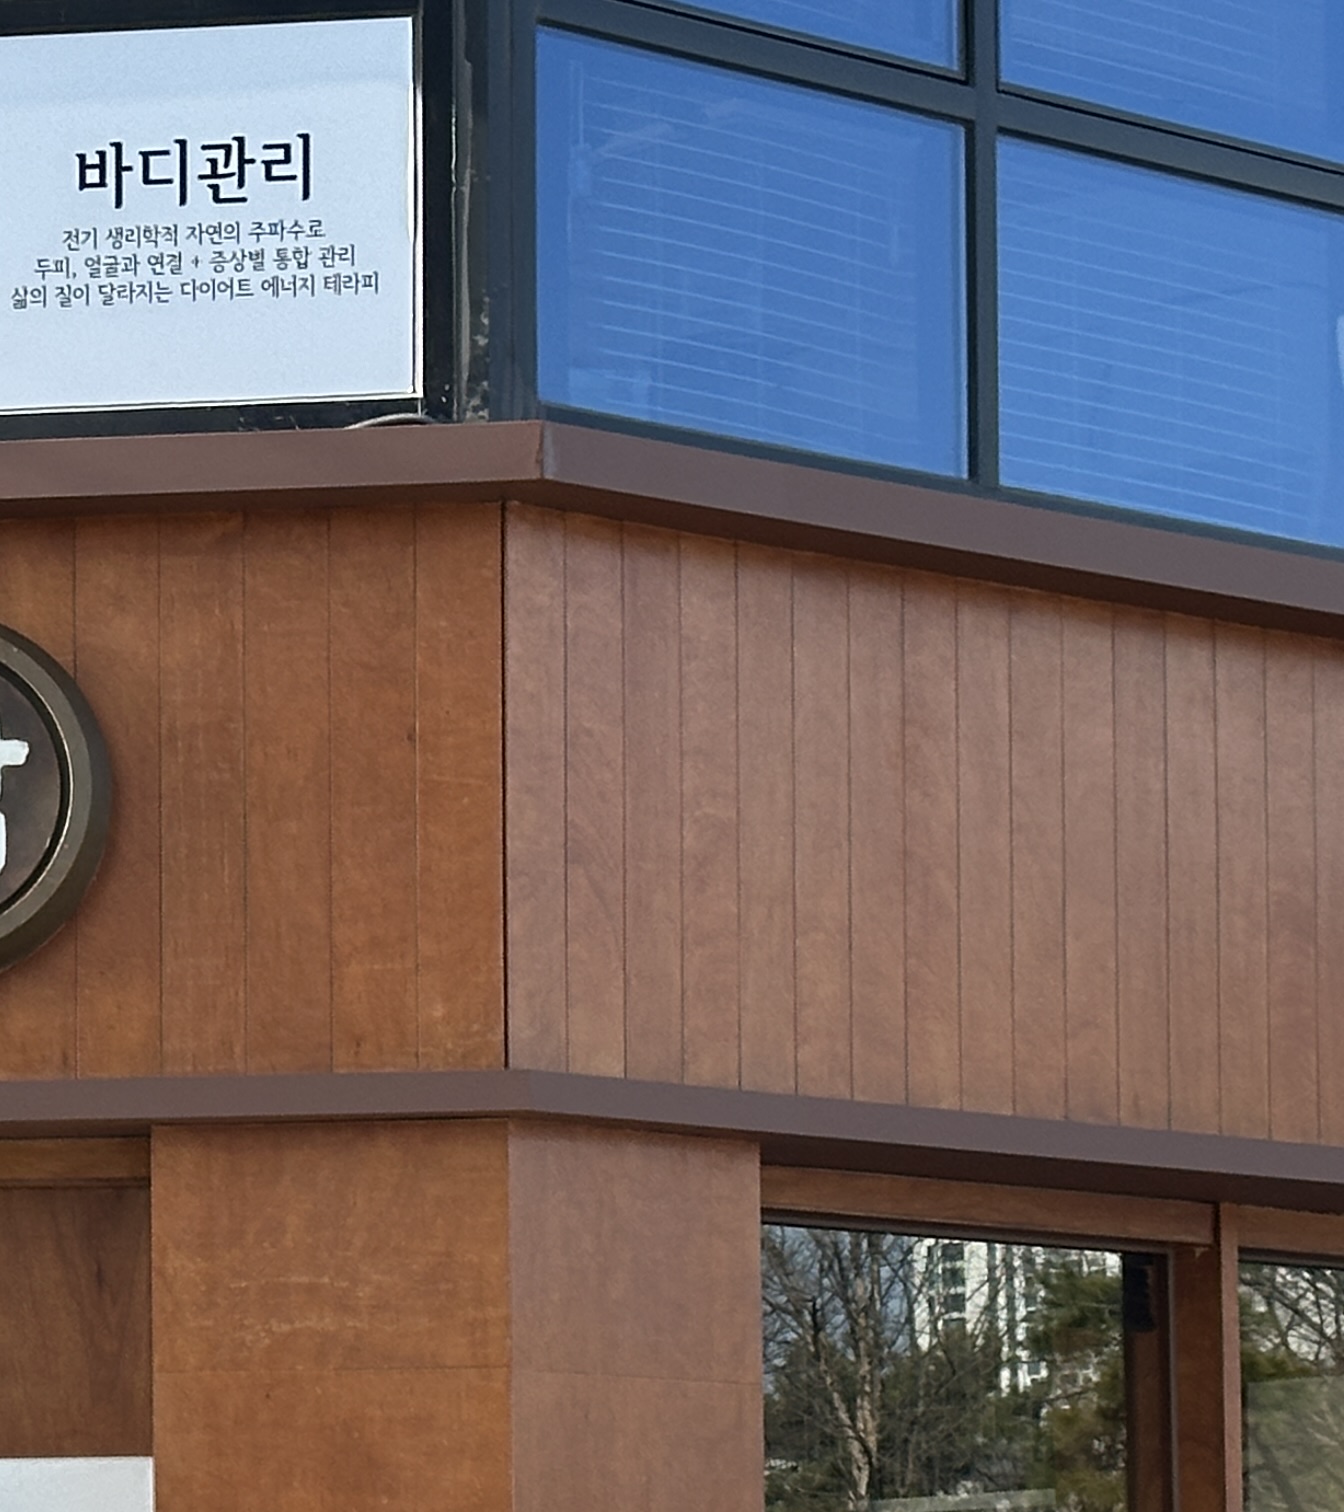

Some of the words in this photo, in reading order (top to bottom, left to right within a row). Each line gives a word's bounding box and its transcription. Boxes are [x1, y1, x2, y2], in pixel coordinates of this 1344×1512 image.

[75, 132, 314, 210] 바디관리
[62, 227, 98, 252] 전기
[184, 220, 241, 247] 자연의
[248, 218, 325, 244] 주파수로
[34, 256, 77, 281] 두피,
[83, 253, 142, 280] 얼굴과
[273, 245, 312, 271] 통합
[318, 243, 358, 269] 관리
[11, 285, 48, 310] 삶의
[54, 282, 91, 308] 질이
[97, 279, 173, 307] 달라지는
[179, 276, 255, 303] 다이어트
[261, 274, 316, 300] 에너지
[323, 270, 381, 297] 테라피
